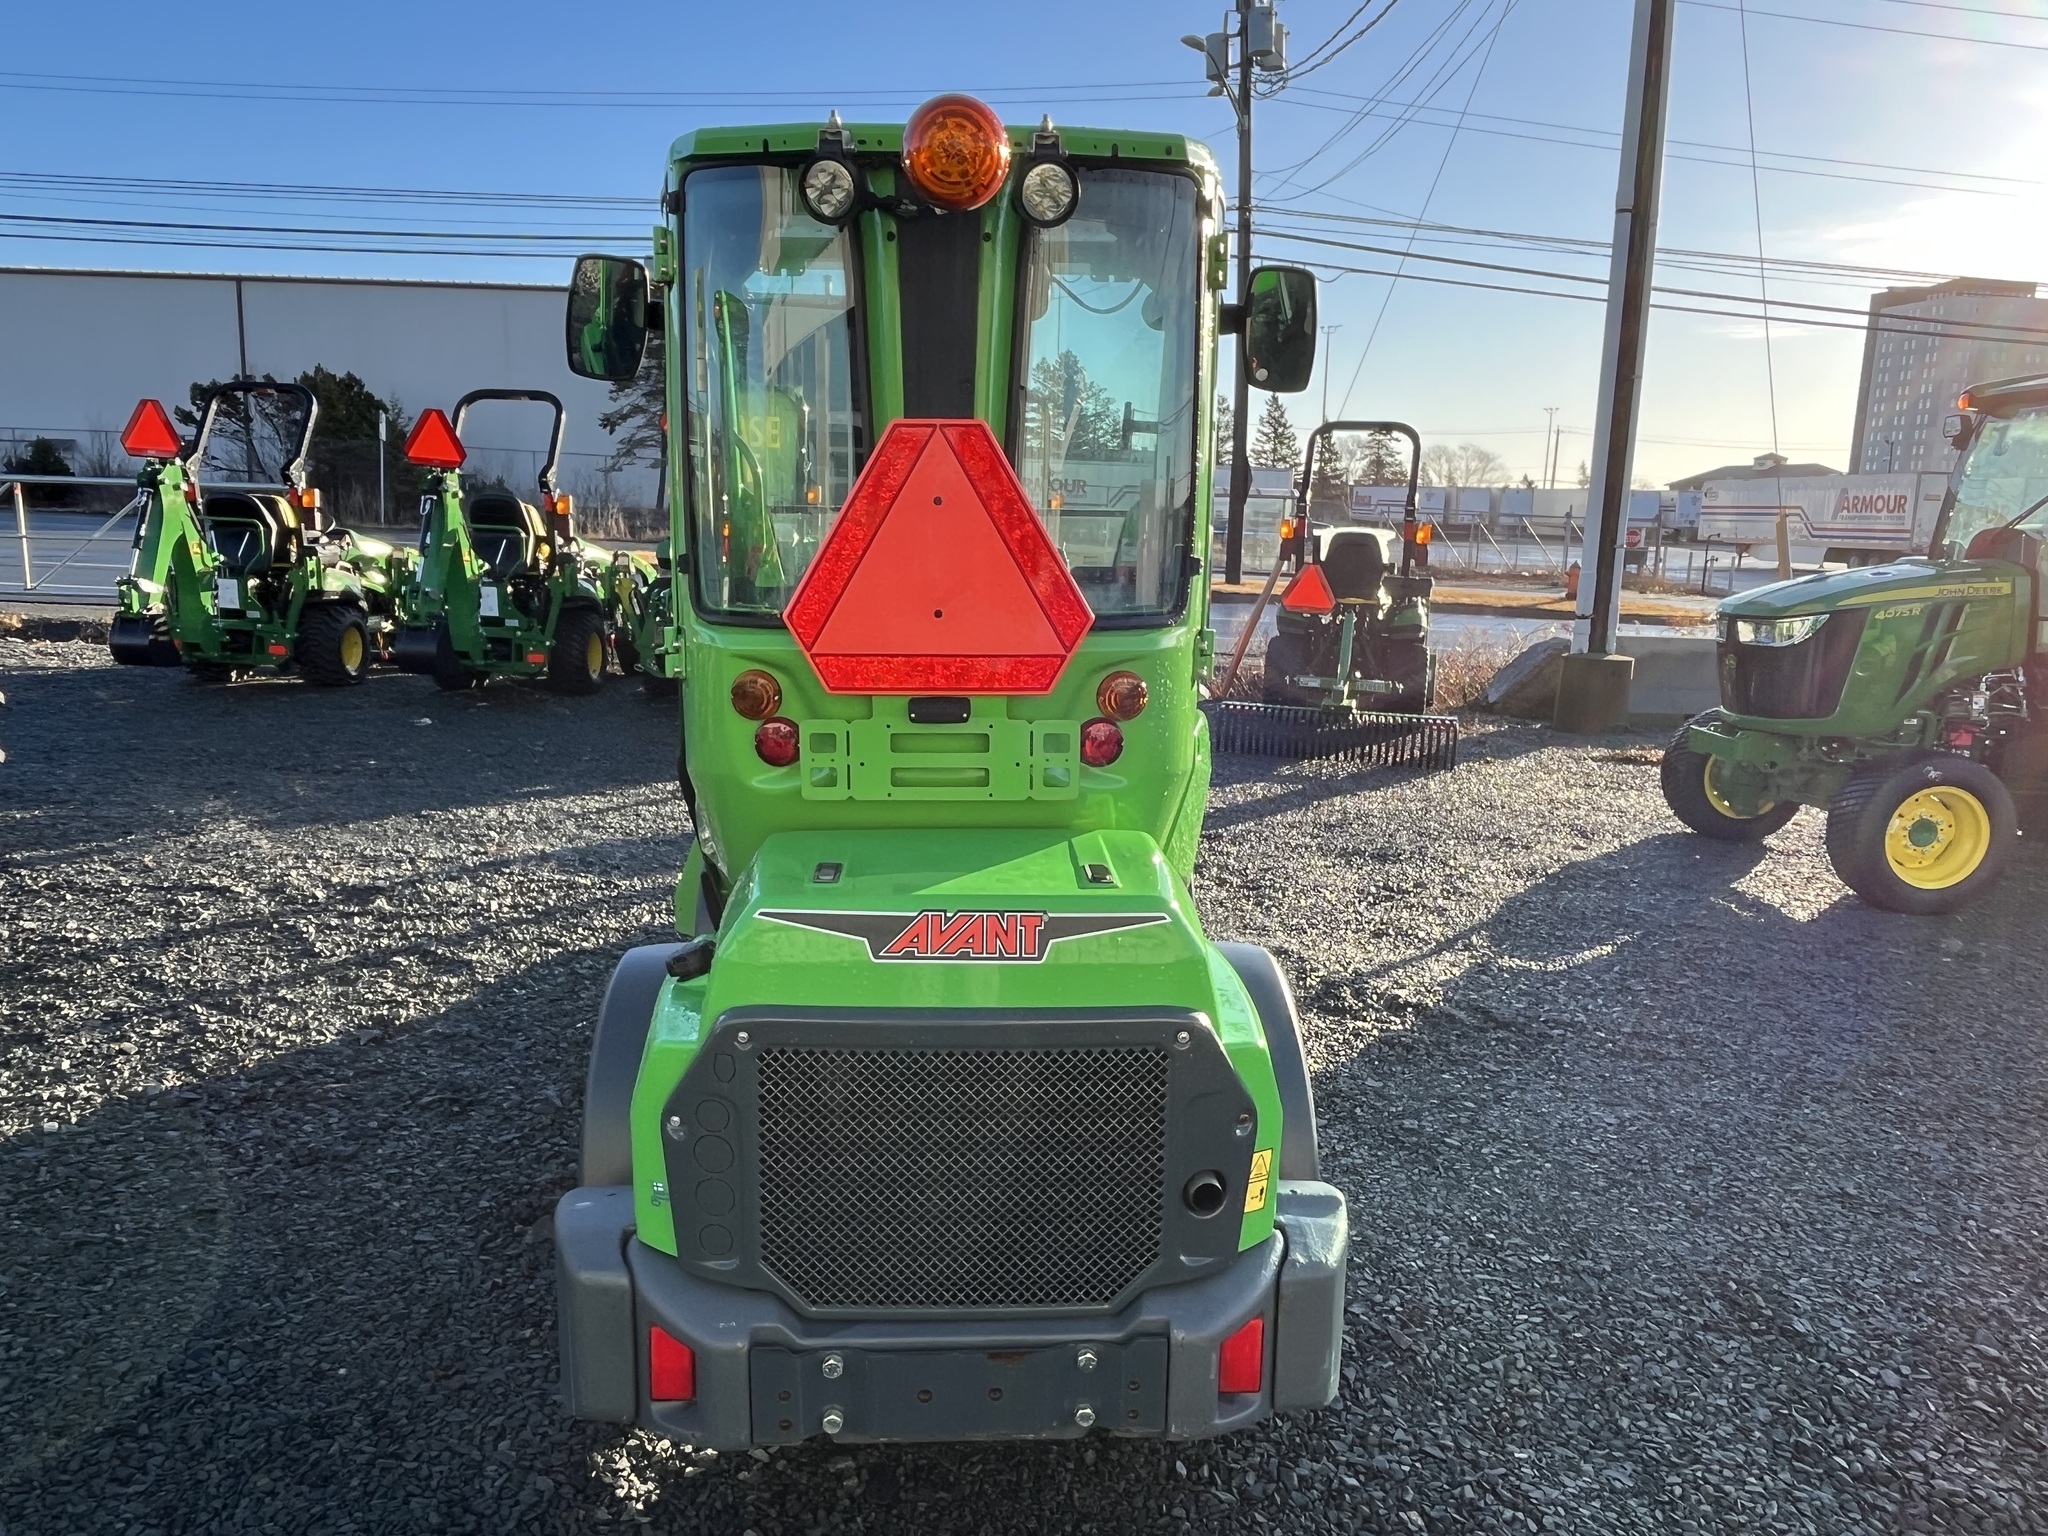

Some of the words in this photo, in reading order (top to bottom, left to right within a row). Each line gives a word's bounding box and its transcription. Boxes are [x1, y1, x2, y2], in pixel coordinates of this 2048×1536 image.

[1838, 494, 1908, 514] ARMOUR
[1934, 587, 1965, 597] JOHN
[1966, 585, 2004, 596] DEERE
[879, 910, 1046, 957] AVANT
